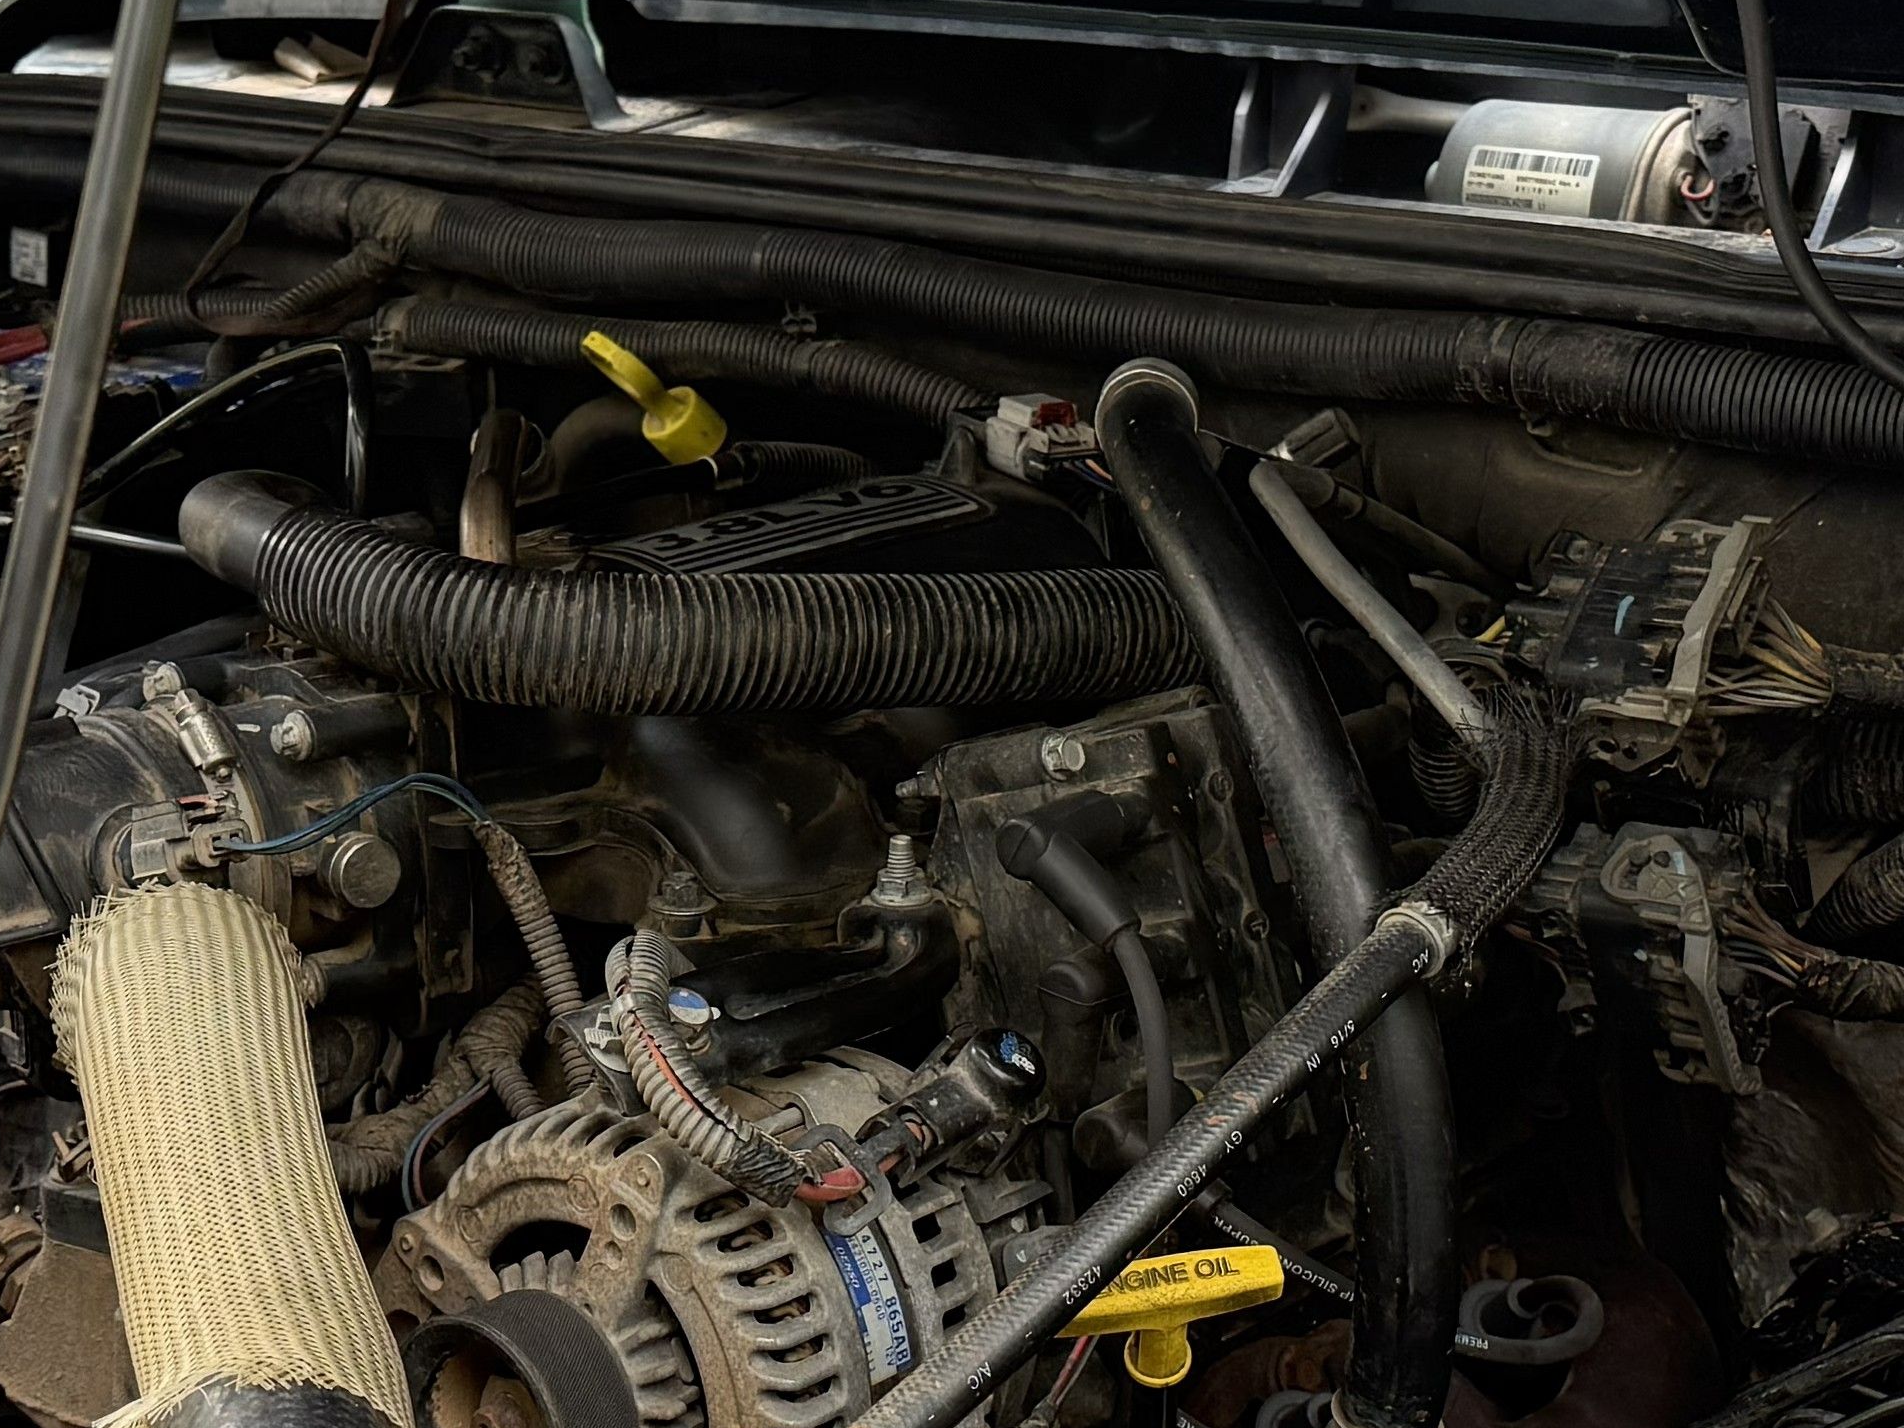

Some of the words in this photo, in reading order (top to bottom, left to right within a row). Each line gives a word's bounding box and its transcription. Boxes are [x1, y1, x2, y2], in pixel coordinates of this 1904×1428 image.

[638, 509, 820, 551] 3.8L
[800, 484, 915, 508] V6
[1330, 1020, 1355, 1049] 5/16
[1306, 1053, 1321, 1072] IN
[1095, 1261, 1189, 1300] NGINE
[1194, 1256, 1240, 1280] OIL
[1279, 1254, 1339, 1294] SILICON
[967, 1361, 992, 1390] A/C
